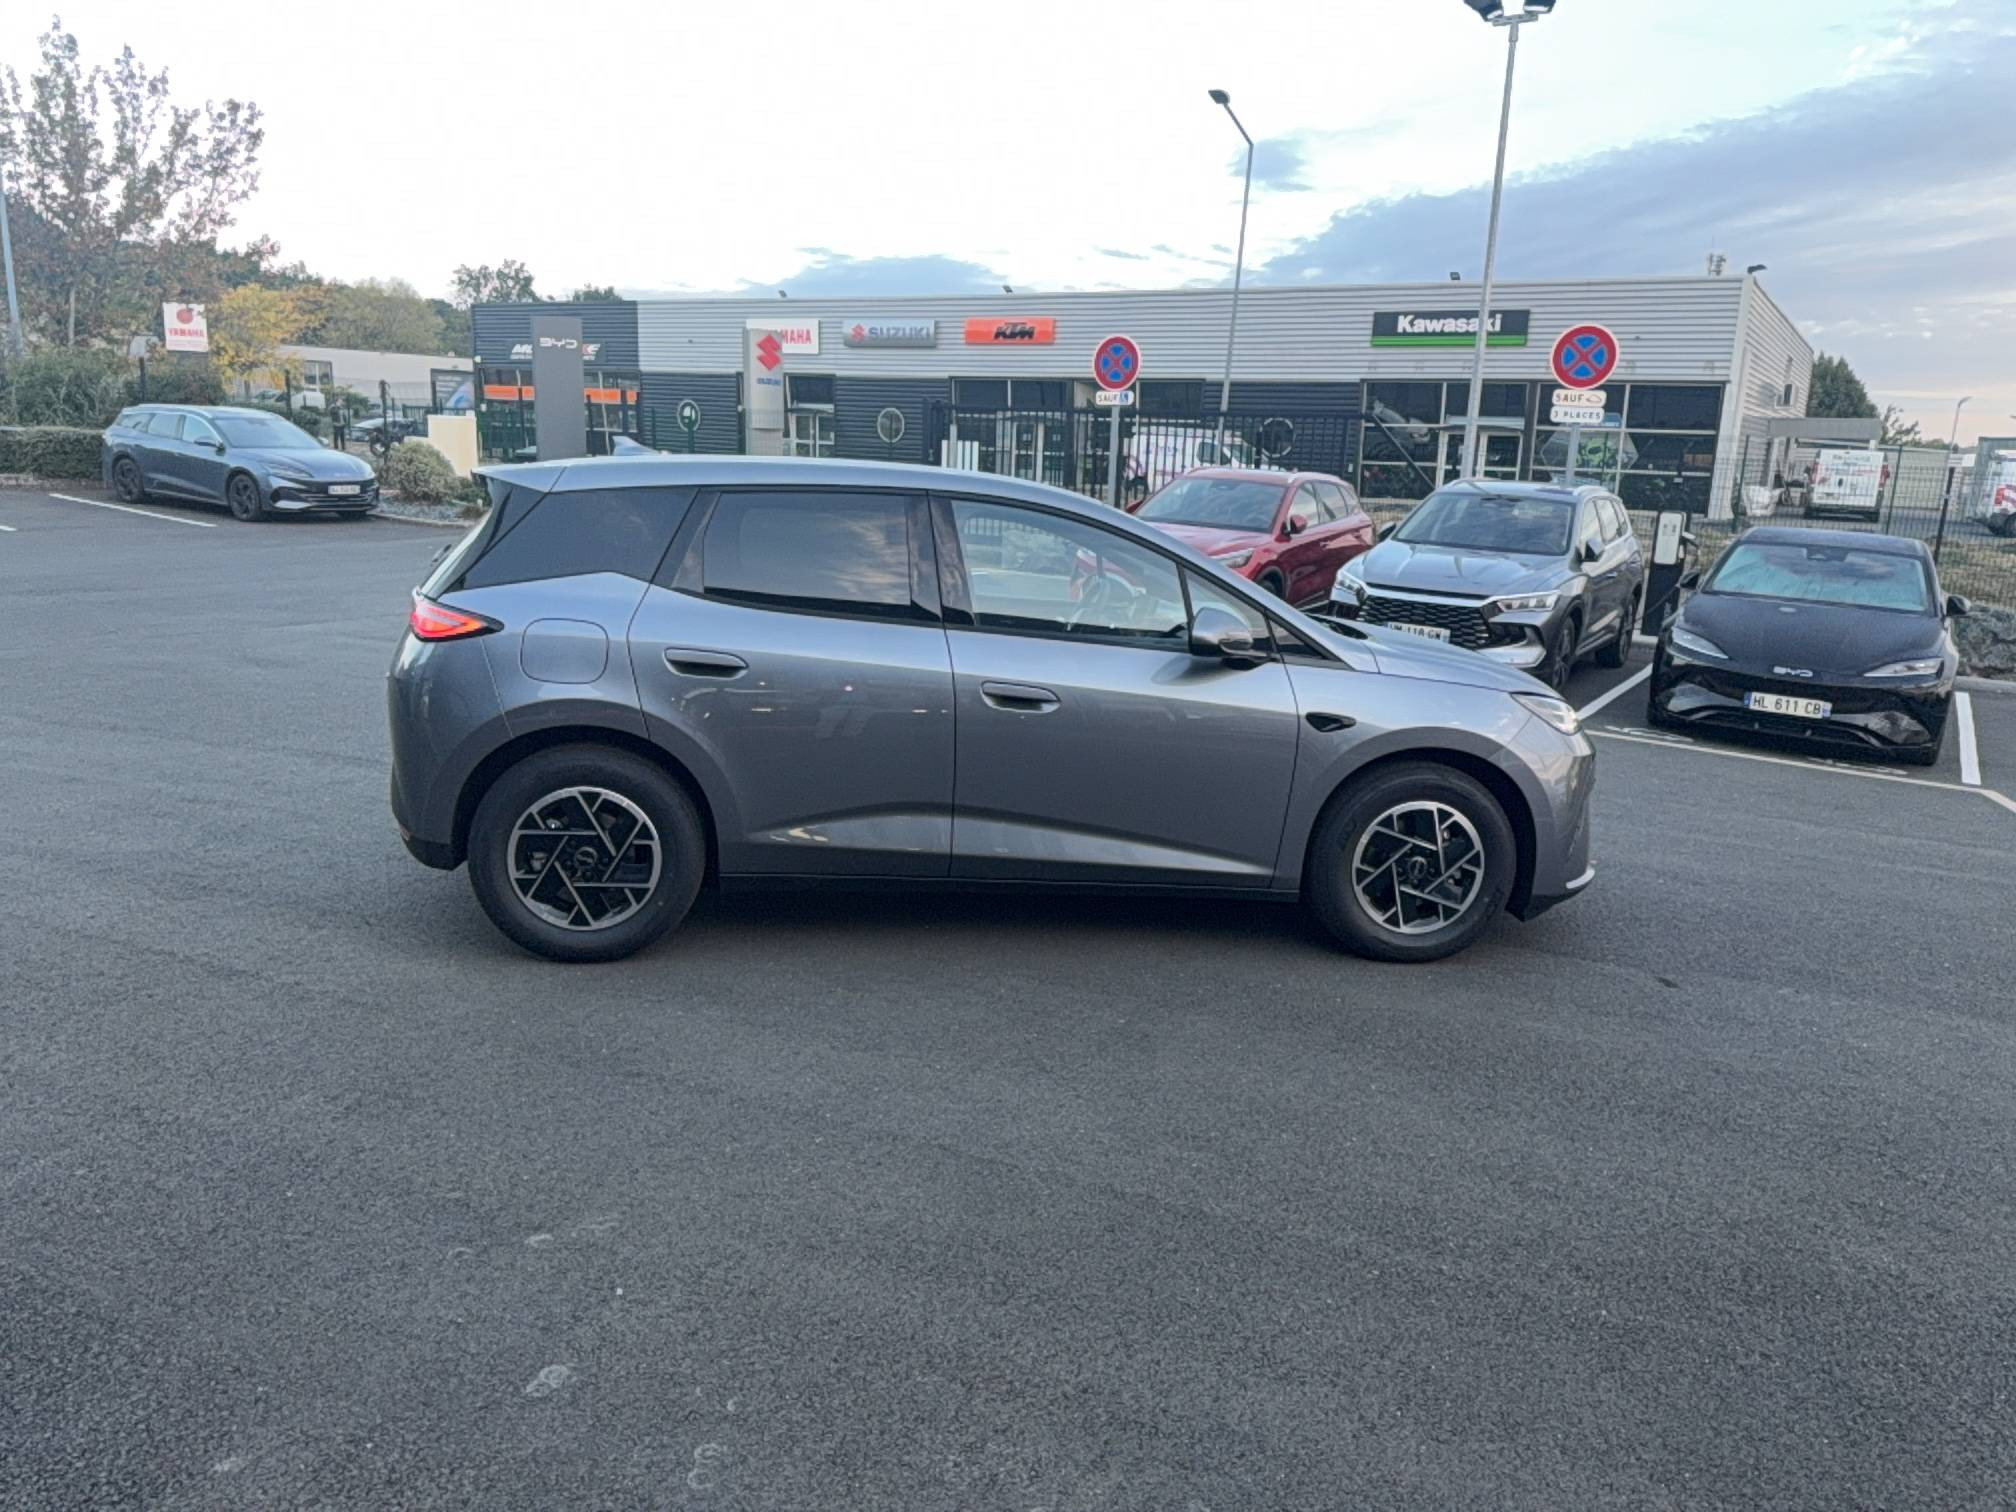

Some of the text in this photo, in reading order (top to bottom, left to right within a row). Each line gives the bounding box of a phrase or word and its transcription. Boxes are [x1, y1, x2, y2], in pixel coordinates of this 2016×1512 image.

[1397, 314, 1502, 333] Kawasaki
[781, 329, 812, 345] MAHA
[868, 326, 931, 340] SUZUKI
[993, 322, 1036, 340] KTM
[539, 337, 578, 349] BYD
[1555, 393, 1585, 403] SAUF
[1563, 411, 1601, 419] PLACES
[1773, 665, 1814, 677] BYD
[1752, 696, 1822, 715] HL 611 CB
